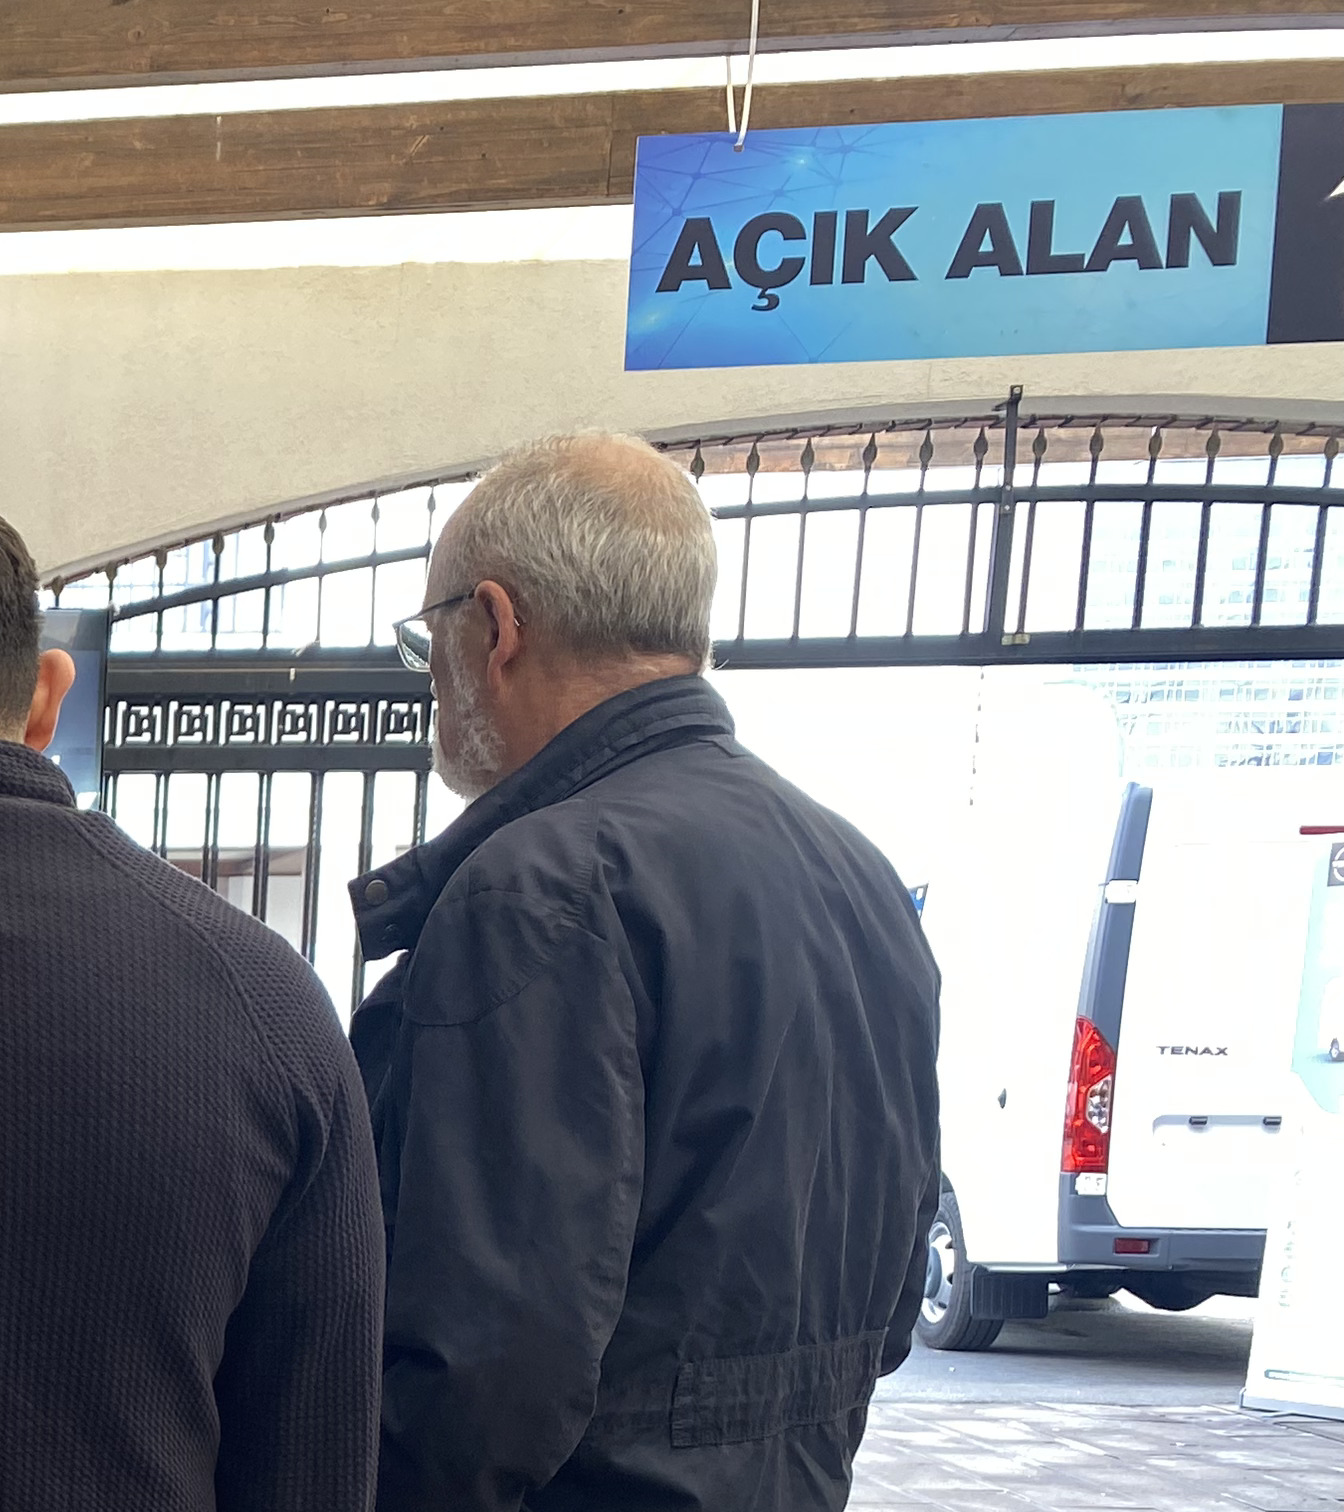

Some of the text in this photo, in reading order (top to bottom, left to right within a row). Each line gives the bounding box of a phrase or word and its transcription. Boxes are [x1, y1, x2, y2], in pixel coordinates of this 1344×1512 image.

[655, 190, 1242, 312] AÇIK ALAN
[1155, 1045, 1228, 1057] TENAX
